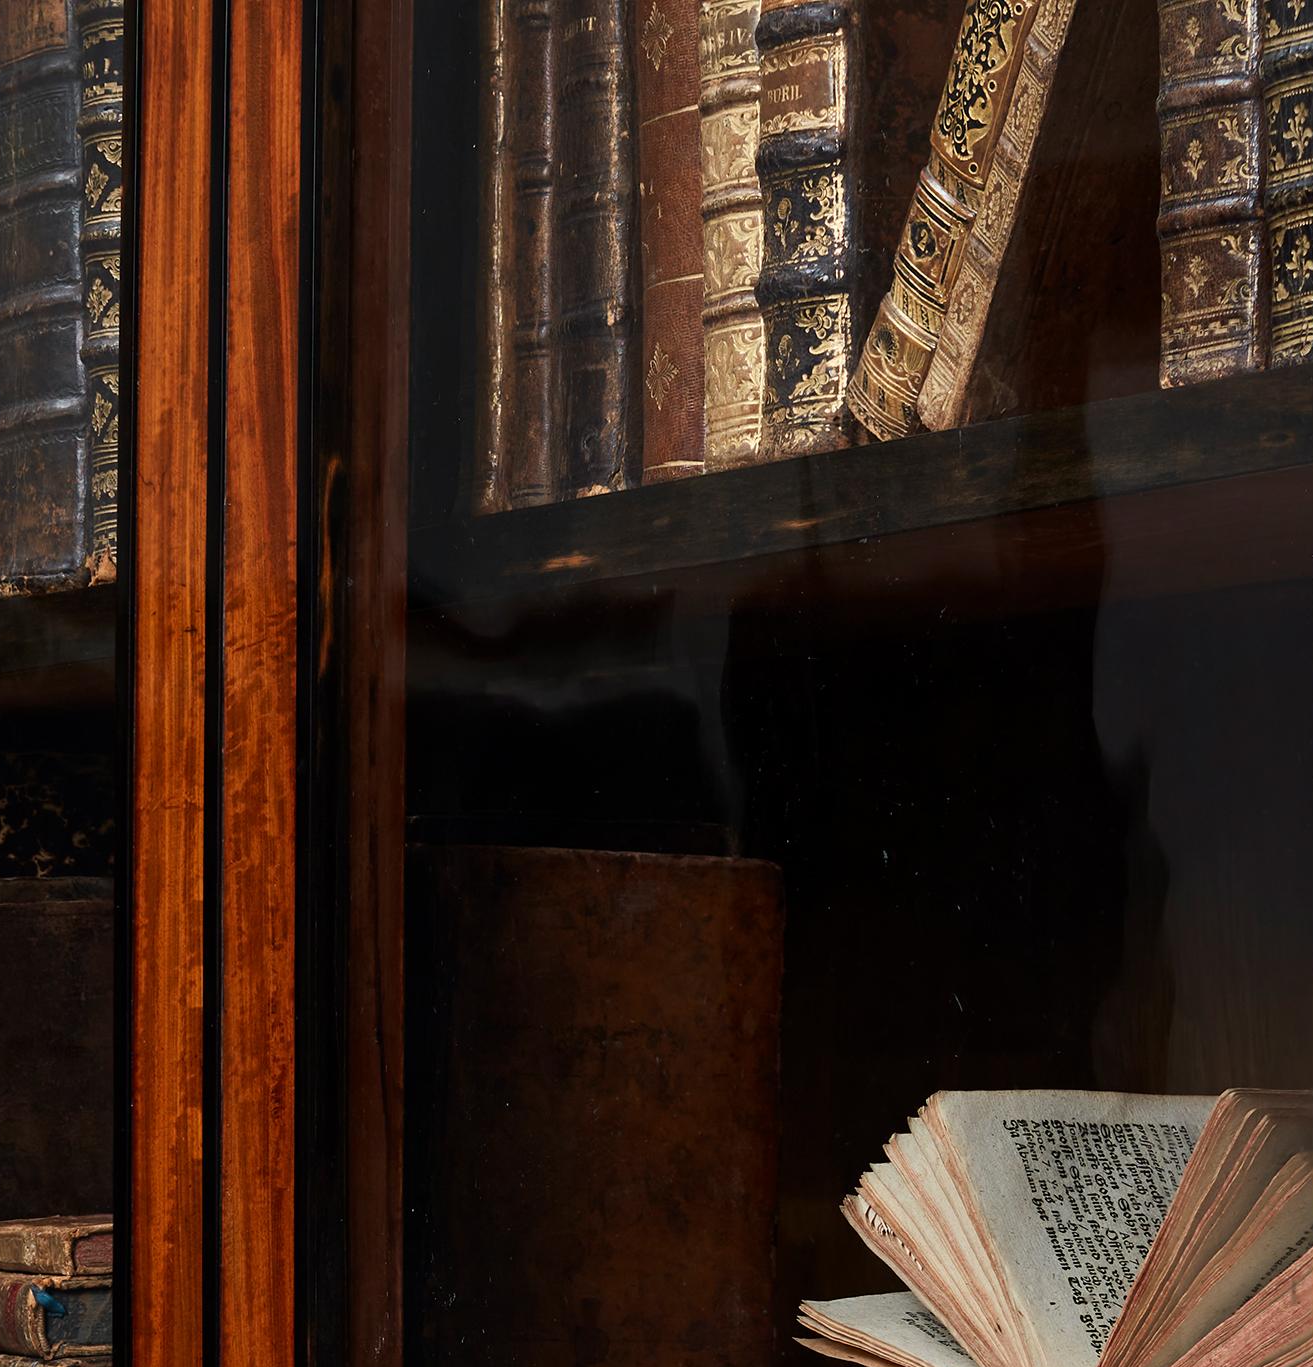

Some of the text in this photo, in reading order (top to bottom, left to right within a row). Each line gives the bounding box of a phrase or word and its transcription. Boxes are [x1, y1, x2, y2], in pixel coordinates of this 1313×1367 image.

[1062, 1120, 1087, 1168] Joannes
[1170, 1124, 1184, 1149] cum
[1014, 1141, 1038, 1194] Abraham
[1031, 1197, 1050, 1222] hat
[1044, 1226, 1072, 1271] meinen
[1067, 1276, 1089, 1306] Tag
[1030, 1119, 1047, 1155] Apoc.
[1066, 1219, 1088, 1256] Haben
[1084, 1262, 1102, 1287] auch
[1098, 1293, 1113, 1309] die
[1038, 1179, 1056, 1204] was
[1050, 1210, 1069, 1234] nach
[1063, 1238, 1083, 1269] ihrem
[1041, 1119, 1056, 1146] vor
[1050, 1150, 1068, 1179] dem
[1084, 1236, 1101, 1261] und
[1069, 1165, 1092, 1216] Schaar
[1111, 1269, 1127, 1293] vor
[1117, 1197, 1140, 1237] Sohn
[1118, 1231, 1135, 1254] Act.
